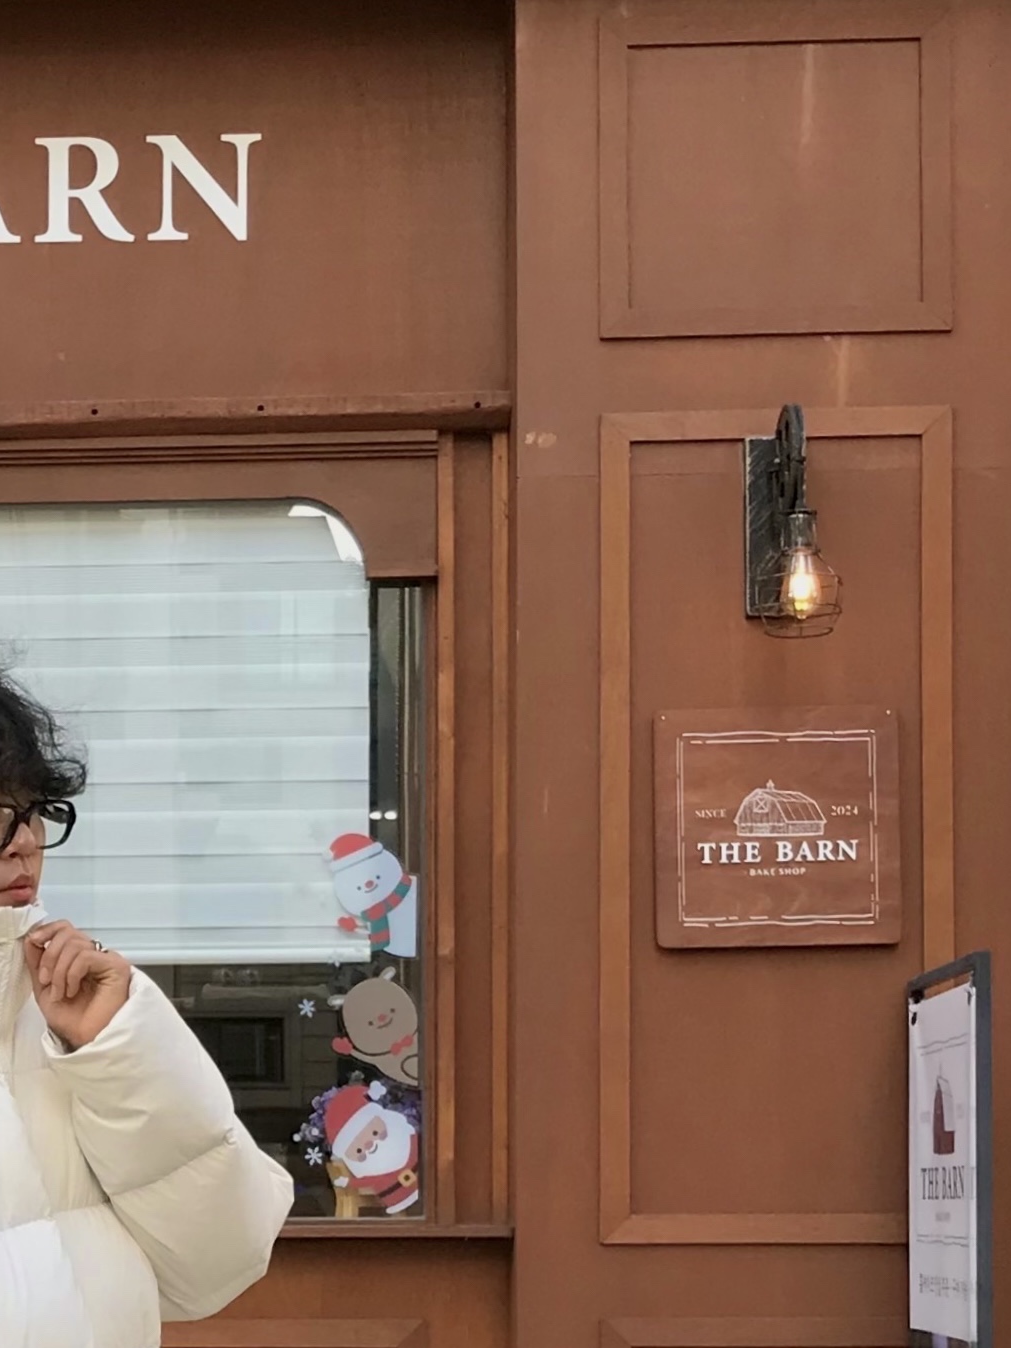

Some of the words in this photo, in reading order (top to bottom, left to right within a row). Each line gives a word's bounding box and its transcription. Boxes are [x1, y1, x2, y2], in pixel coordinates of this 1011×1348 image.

[695, 808, 727, 819] SINCE
[830, 804, 859, 816] 2024
[697, 842, 761, 864] THE
[775, 839, 859, 862] BARN
[749, 867, 775, 877] BAKE
[778, 867, 806, 876] SHOP
[920, 1167, 939, 1200] THE
[941, 1165, 965, 1200] BARN
